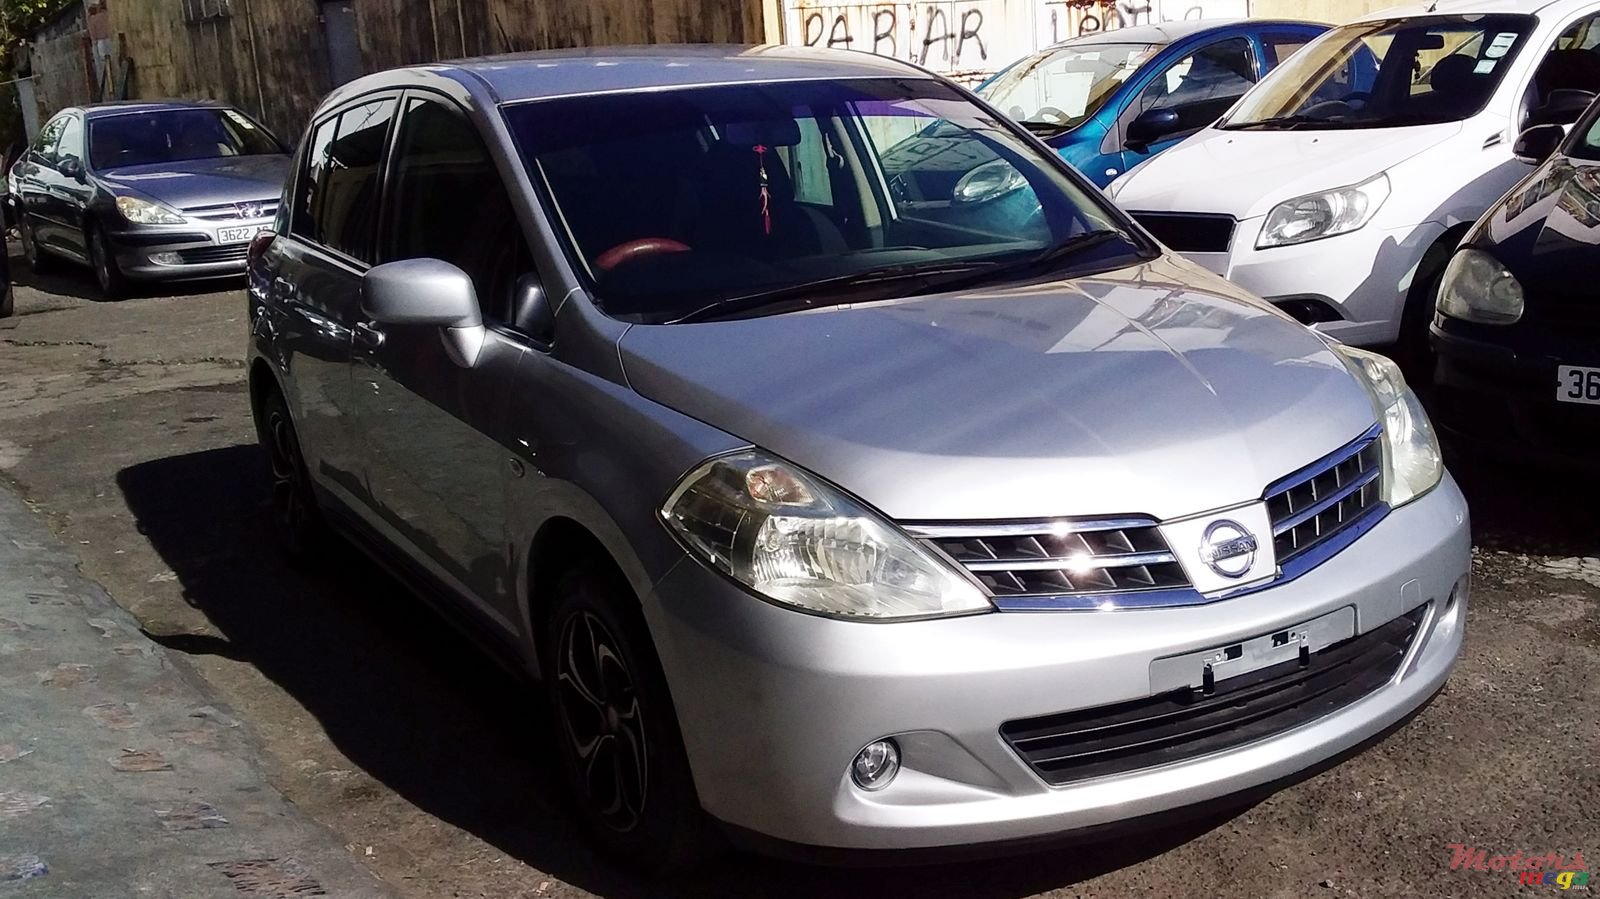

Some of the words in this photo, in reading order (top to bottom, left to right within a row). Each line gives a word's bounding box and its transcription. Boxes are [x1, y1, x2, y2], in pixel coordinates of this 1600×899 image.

[221, 228, 250, 241] 3622
[1567, 369, 1600, 400] 36
[1209, 540, 1255, 559] NISSAN
